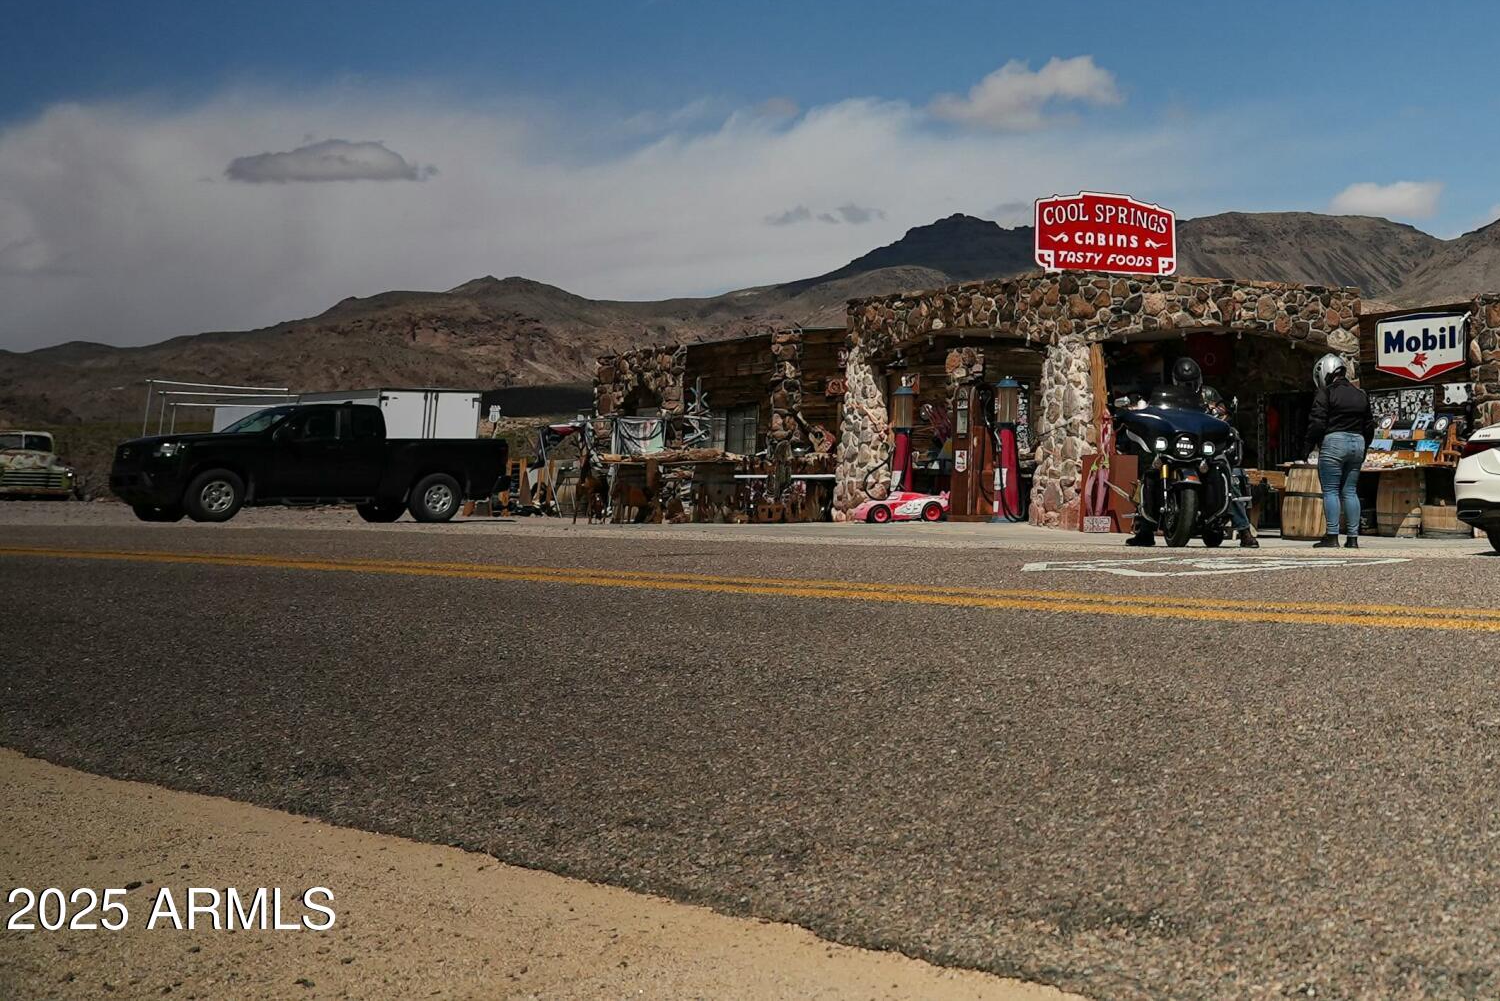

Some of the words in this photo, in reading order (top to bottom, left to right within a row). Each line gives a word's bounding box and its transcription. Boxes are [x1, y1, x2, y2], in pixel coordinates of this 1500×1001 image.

[1043, 203, 1089, 226] COOL
[1095, 204, 1168, 234] SPRINGS
[1058, 250, 1103, 265] TASTY
[1106, 254, 1153, 267] FOODS
[1384, 325, 1456, 354] Mobil
